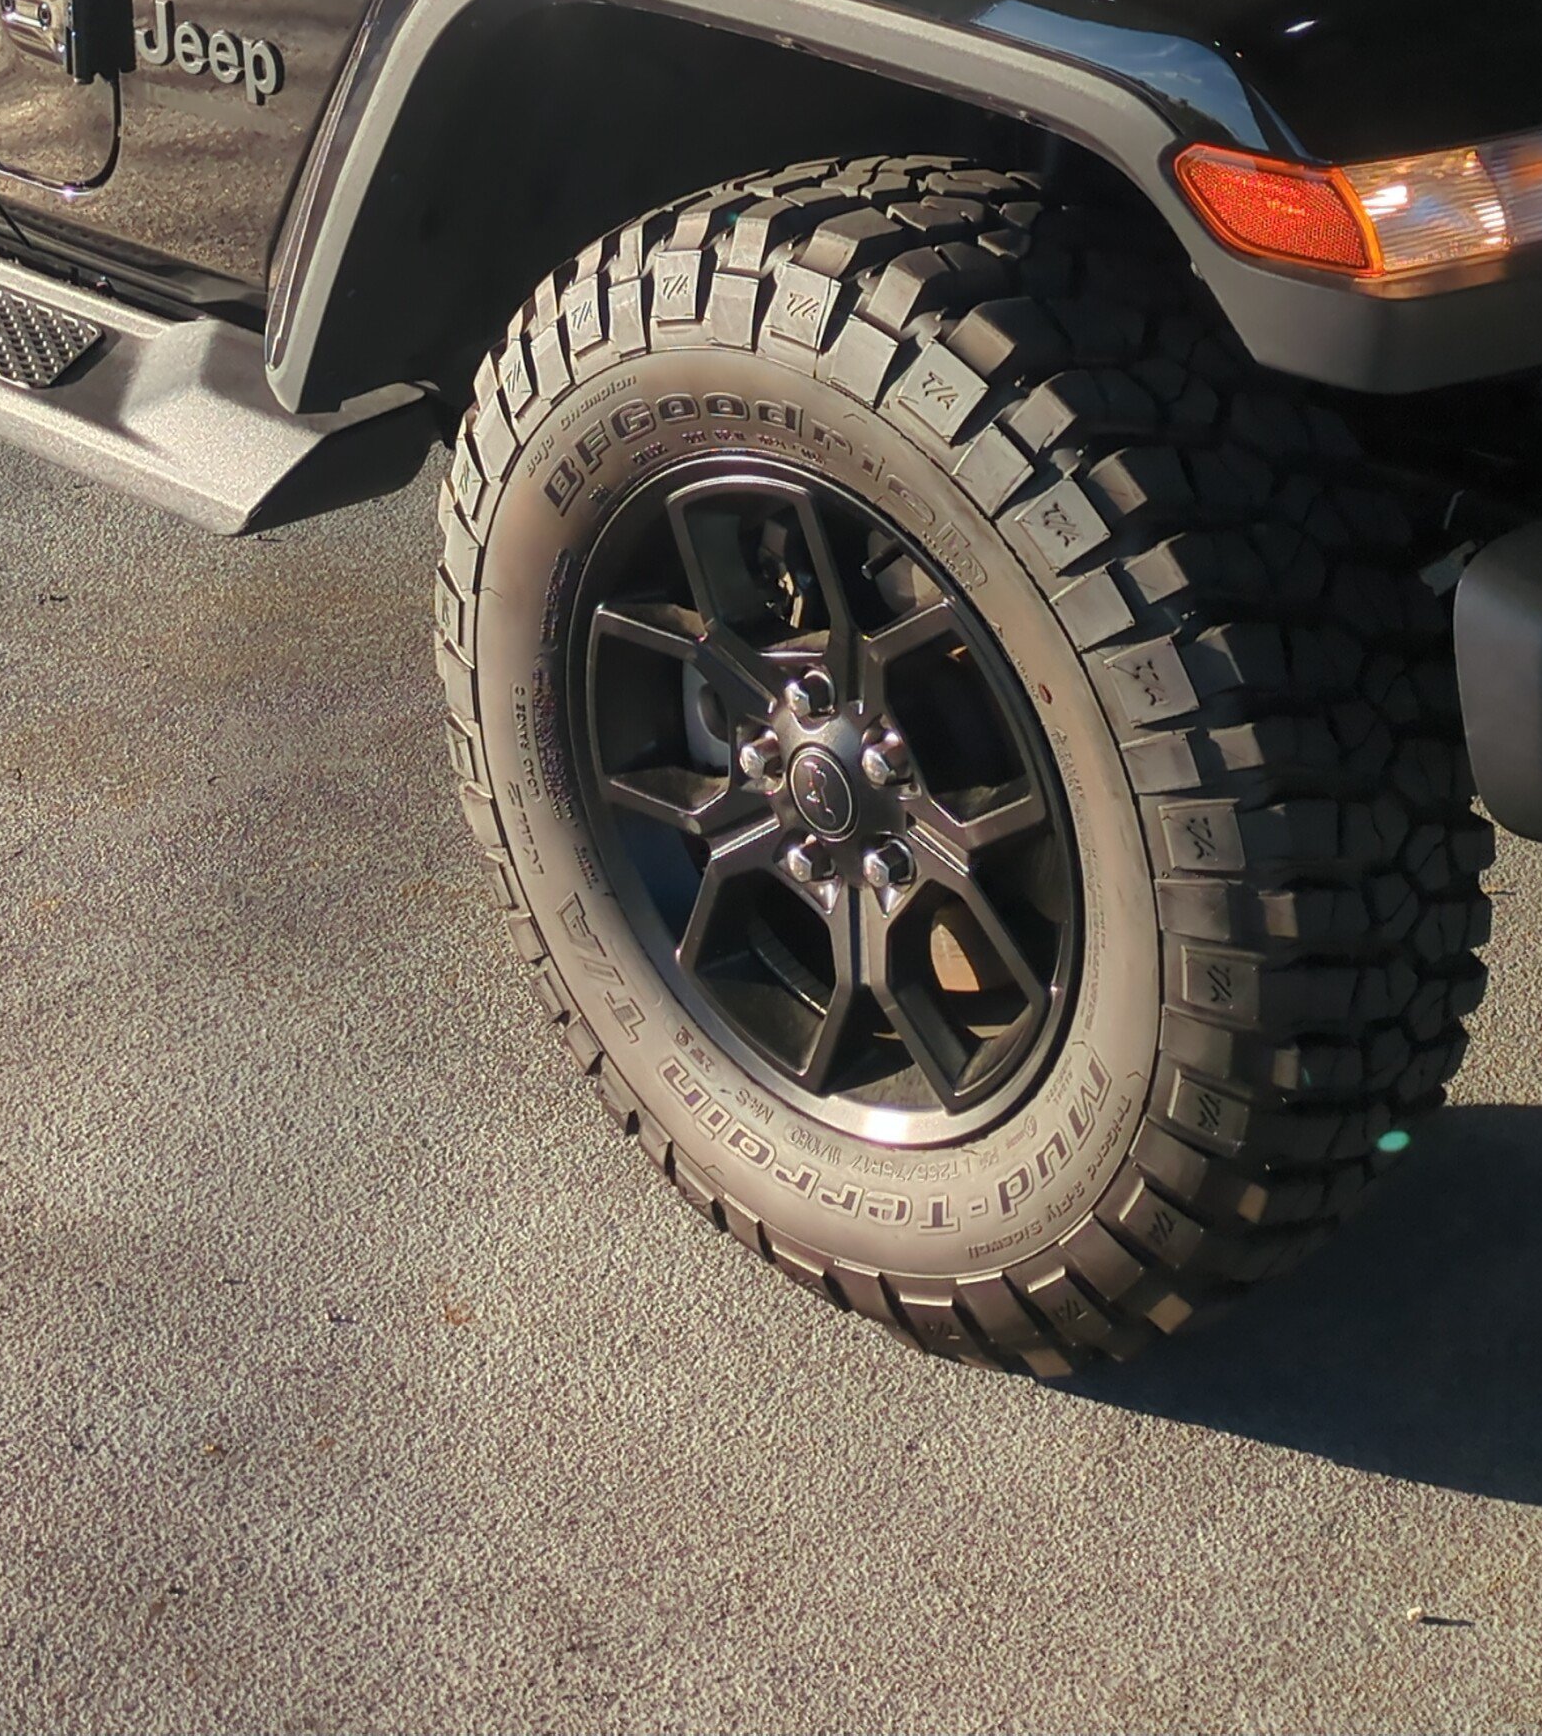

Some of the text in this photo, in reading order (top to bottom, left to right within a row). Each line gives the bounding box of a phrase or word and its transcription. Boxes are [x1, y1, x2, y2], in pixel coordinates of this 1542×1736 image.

[661, 271, 690, 301] T/A
[787, 290, 820, 323] T/A
[526, 434, 555, 478] Baja
[560, 374, 637, 432] Champion
[922, 371, 960, 411] T/A
[542, 391, 988, 588] BFGoodrich
[555, 891, 647, 1045] T/A
[659, 1045, 1113, 1235] Mud-Terrain
[967, 1221, 1044, 1260] Sidewall
